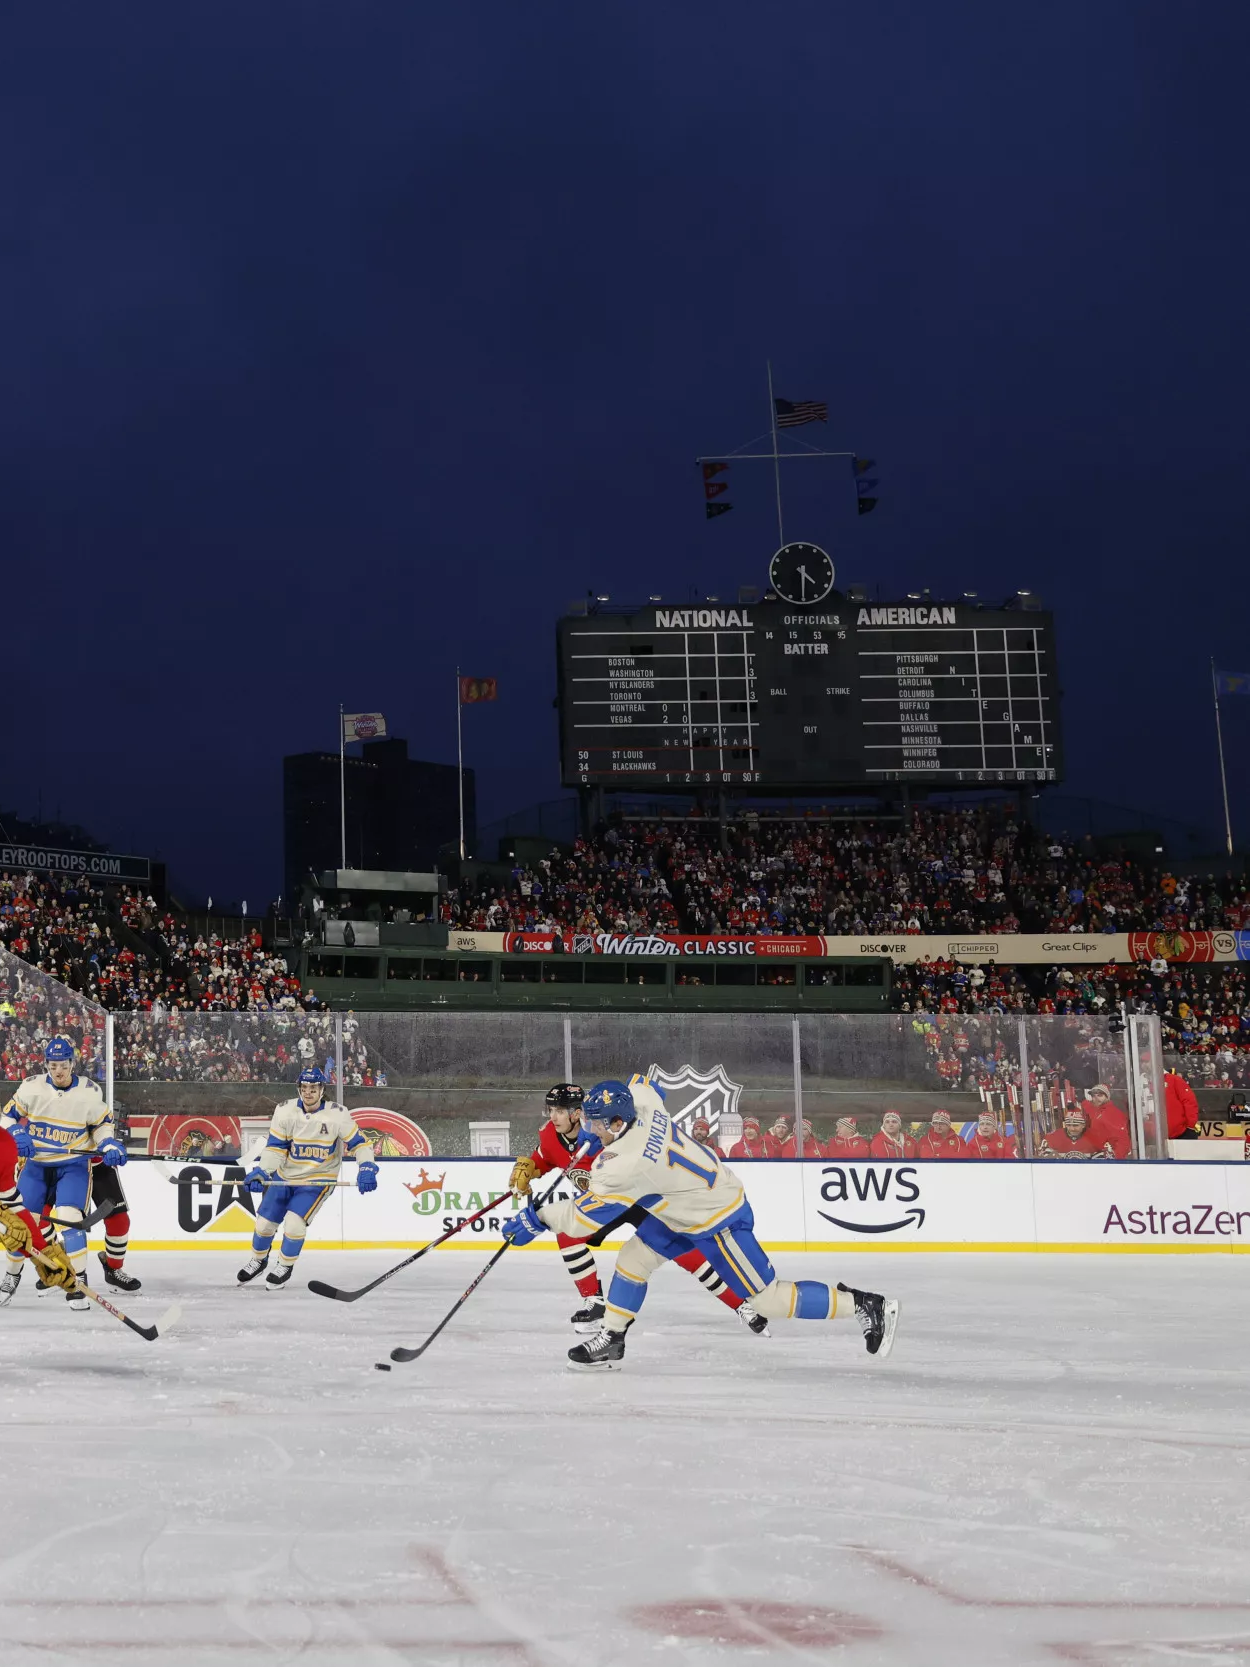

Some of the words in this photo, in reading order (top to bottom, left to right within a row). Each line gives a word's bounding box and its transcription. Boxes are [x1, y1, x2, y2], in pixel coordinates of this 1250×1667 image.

[655, 610, 754, 628] NATIONAL
[784, 616, 840, 625] OFFICIALS
[856, 607, 956, 625] AMERICAN
[789, 631, 797, 639] 15
[813, 631, 822, 640] 53
[837, 631, 846, 640] 95
[784, 643, 829, 655] BATTER
[608, 658, 635, 666] BOSTON
[896, 655, 939, 663] PITTSBURGH
[609, 669, 654, 678] WASHINGTON
[749, 669, 755, 677] 3
[897, 666, 924, 675] DETROIT
[619, 681, 655, 689] ISLANDERS
[898, 678, 932, 686] CAROLINA
[610, 692, 642, 700] TORONTO
[750, 692, 756, 700] 3
[770, 688, 787, 696] BALL
[826, 687, 850, 695] STRIKE
[898, 690, 935, 698] COLUMBUS
[610, 704, 646, 712] MONTREAL
[662, 704, 668, 712] 0
[899, 702, 930, 710] BUFFALO
[610, 715, 632, 723] VEGAS
[662, 715, 668, 723] 2
[900, 713, 929, 721] DALLAS
[901, 725, 938, 733] NASHVILLE
[901, 736, 942, 745] MINNESOTA
[578, 751, 589, 760] 50
[612, 751, 621, 759] ST
[623, 751, 643, 759] LOUIS
[902, 748, 937, 757] WINNIPEG
[578, 763, 589, 771] 34
[612, 762, 657, 770] BLACKHAWKS
[903, 760, 940, 769] COLORADO
[581, 774, 587, 782] G
[666, 773, 670, 782] 1
[685, 773, 690, 782] 2
[705, 773, 710, 782] 3
[723, 773, 731, 782] OT
[743, 773, 751, 782] SO
[1017, 771, 1026, 780] OT
[457, 937, 476, 945] aws
[596, 934, 681, 956] Winter
[684, 941, 756, 955] CLASSIC
[1217, 939, 1233, 948] VS
[523, 941, 569, 951] DISCOR
[766, 945, 801, 953] CHICAGO
[860, 944, 906, 953] DISCOVER
[1041, 942, 1071, 951] Great
[1073, 942, 1097, 952] Clips
[320, 1123, 329, 1135] A
[1199, 1121, 1225, 1138] ws
[28, 1124, 44, 1138] ST.
[45, 1128, 79, 1144] LOUIS
[642, 1110, 668, 1163] FOWLER
[164, 1155, 201, 1163] CCM
[820, 1166, 921, 1202] aws
[178, 1166, 256, 1232] CA
